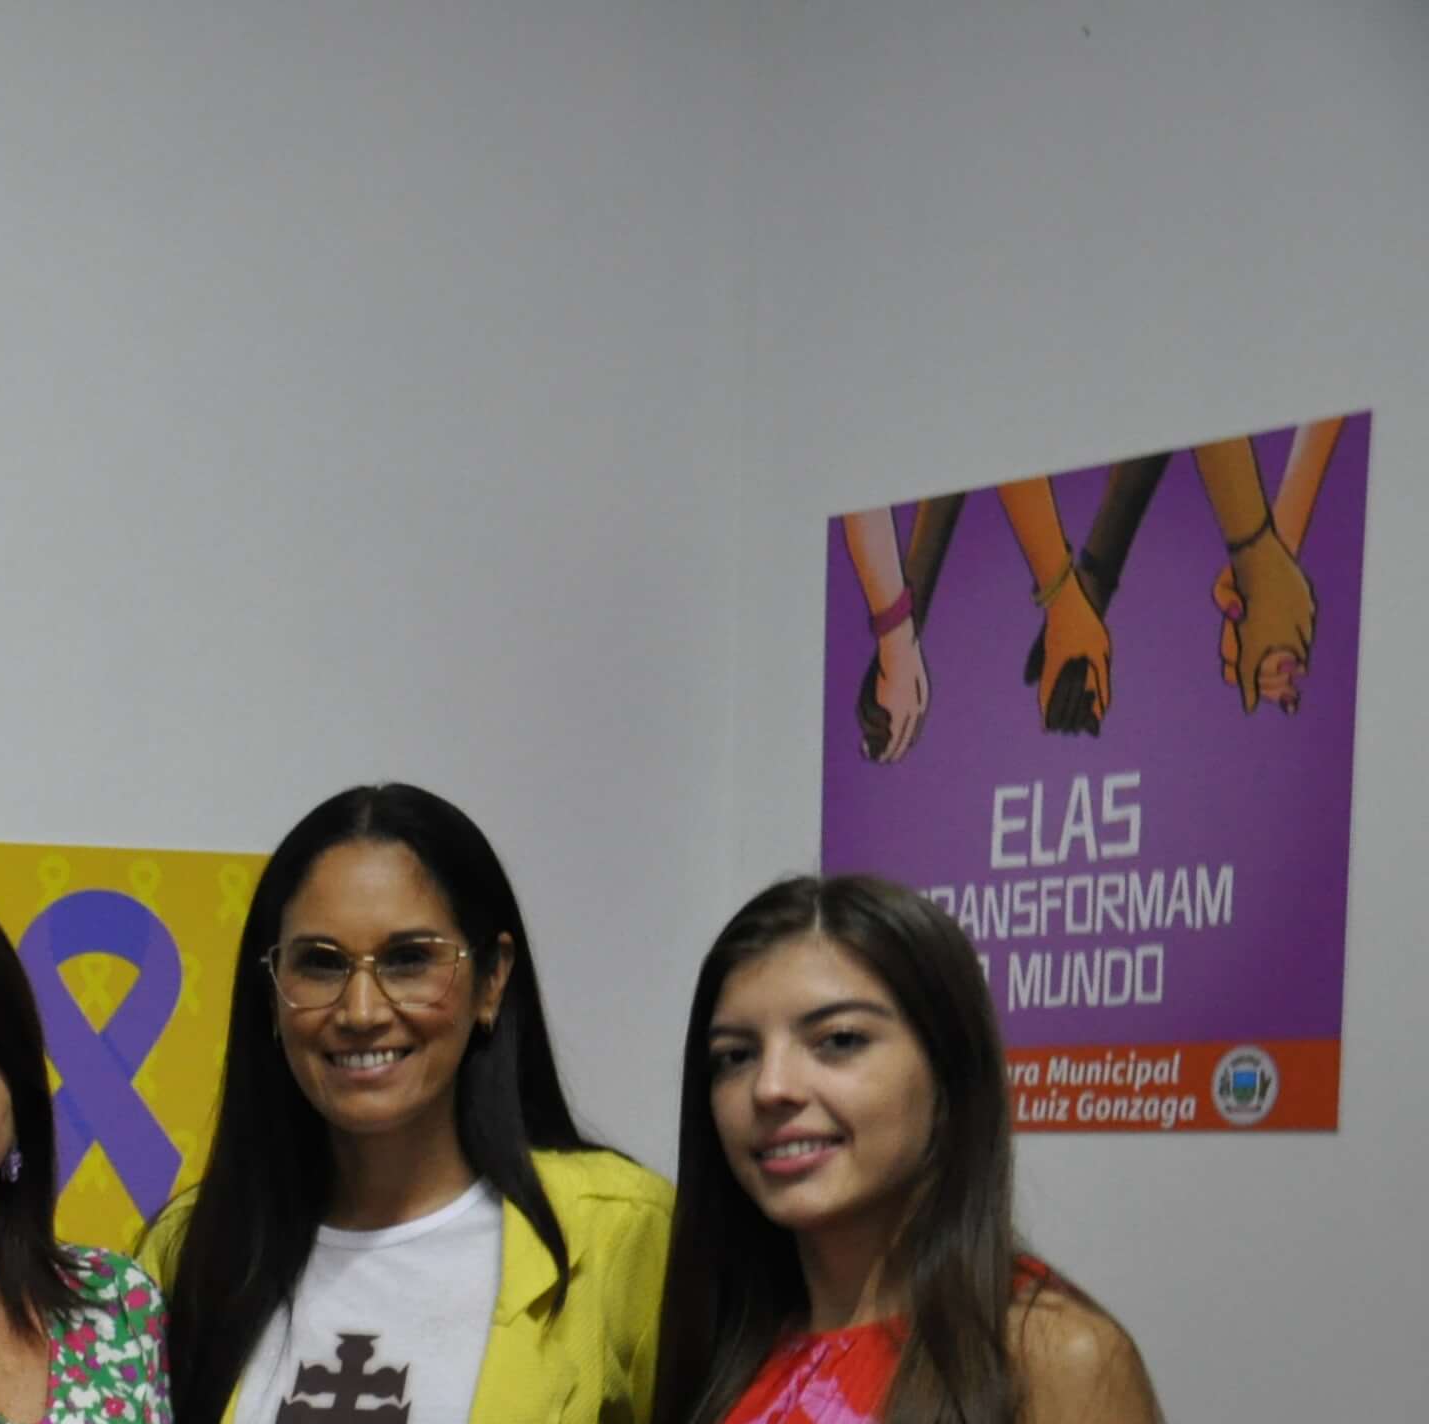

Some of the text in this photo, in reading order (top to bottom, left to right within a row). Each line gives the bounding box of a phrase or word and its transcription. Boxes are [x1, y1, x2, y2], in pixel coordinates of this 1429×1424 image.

[991, 772, 1141, 869] ELAS
[917, 864, 1234, 940] ANSFORMAM
[1008, 943, 1164, 1013] MUNDO
[1046, 1050, 1181, 1092] Municipal
[1017, 1087, 1198, 1129] Luiz Gonzaga
